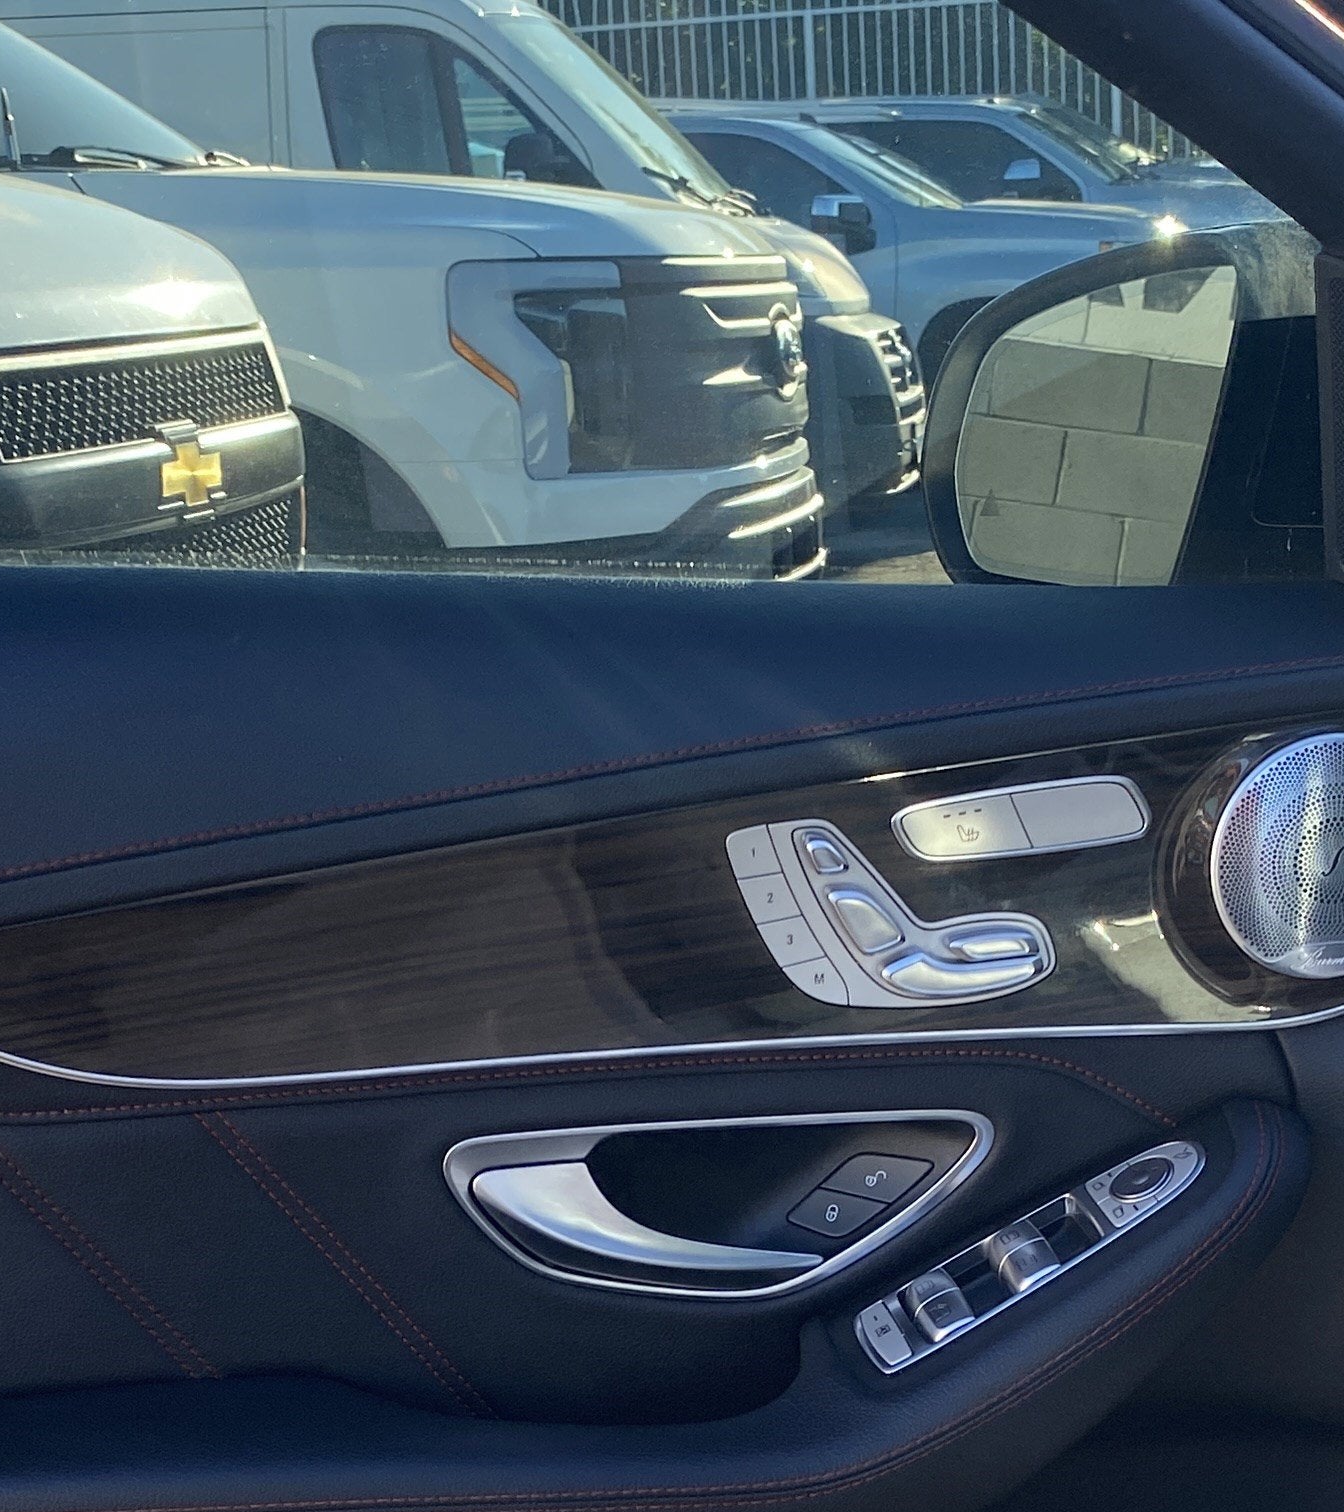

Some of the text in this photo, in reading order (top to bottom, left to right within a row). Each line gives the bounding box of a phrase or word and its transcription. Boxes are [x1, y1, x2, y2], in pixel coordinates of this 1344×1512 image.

[767, 893, 774, 904] 2
[787, 934, 794, 945] 3
[814, 973, 825, 985] M
